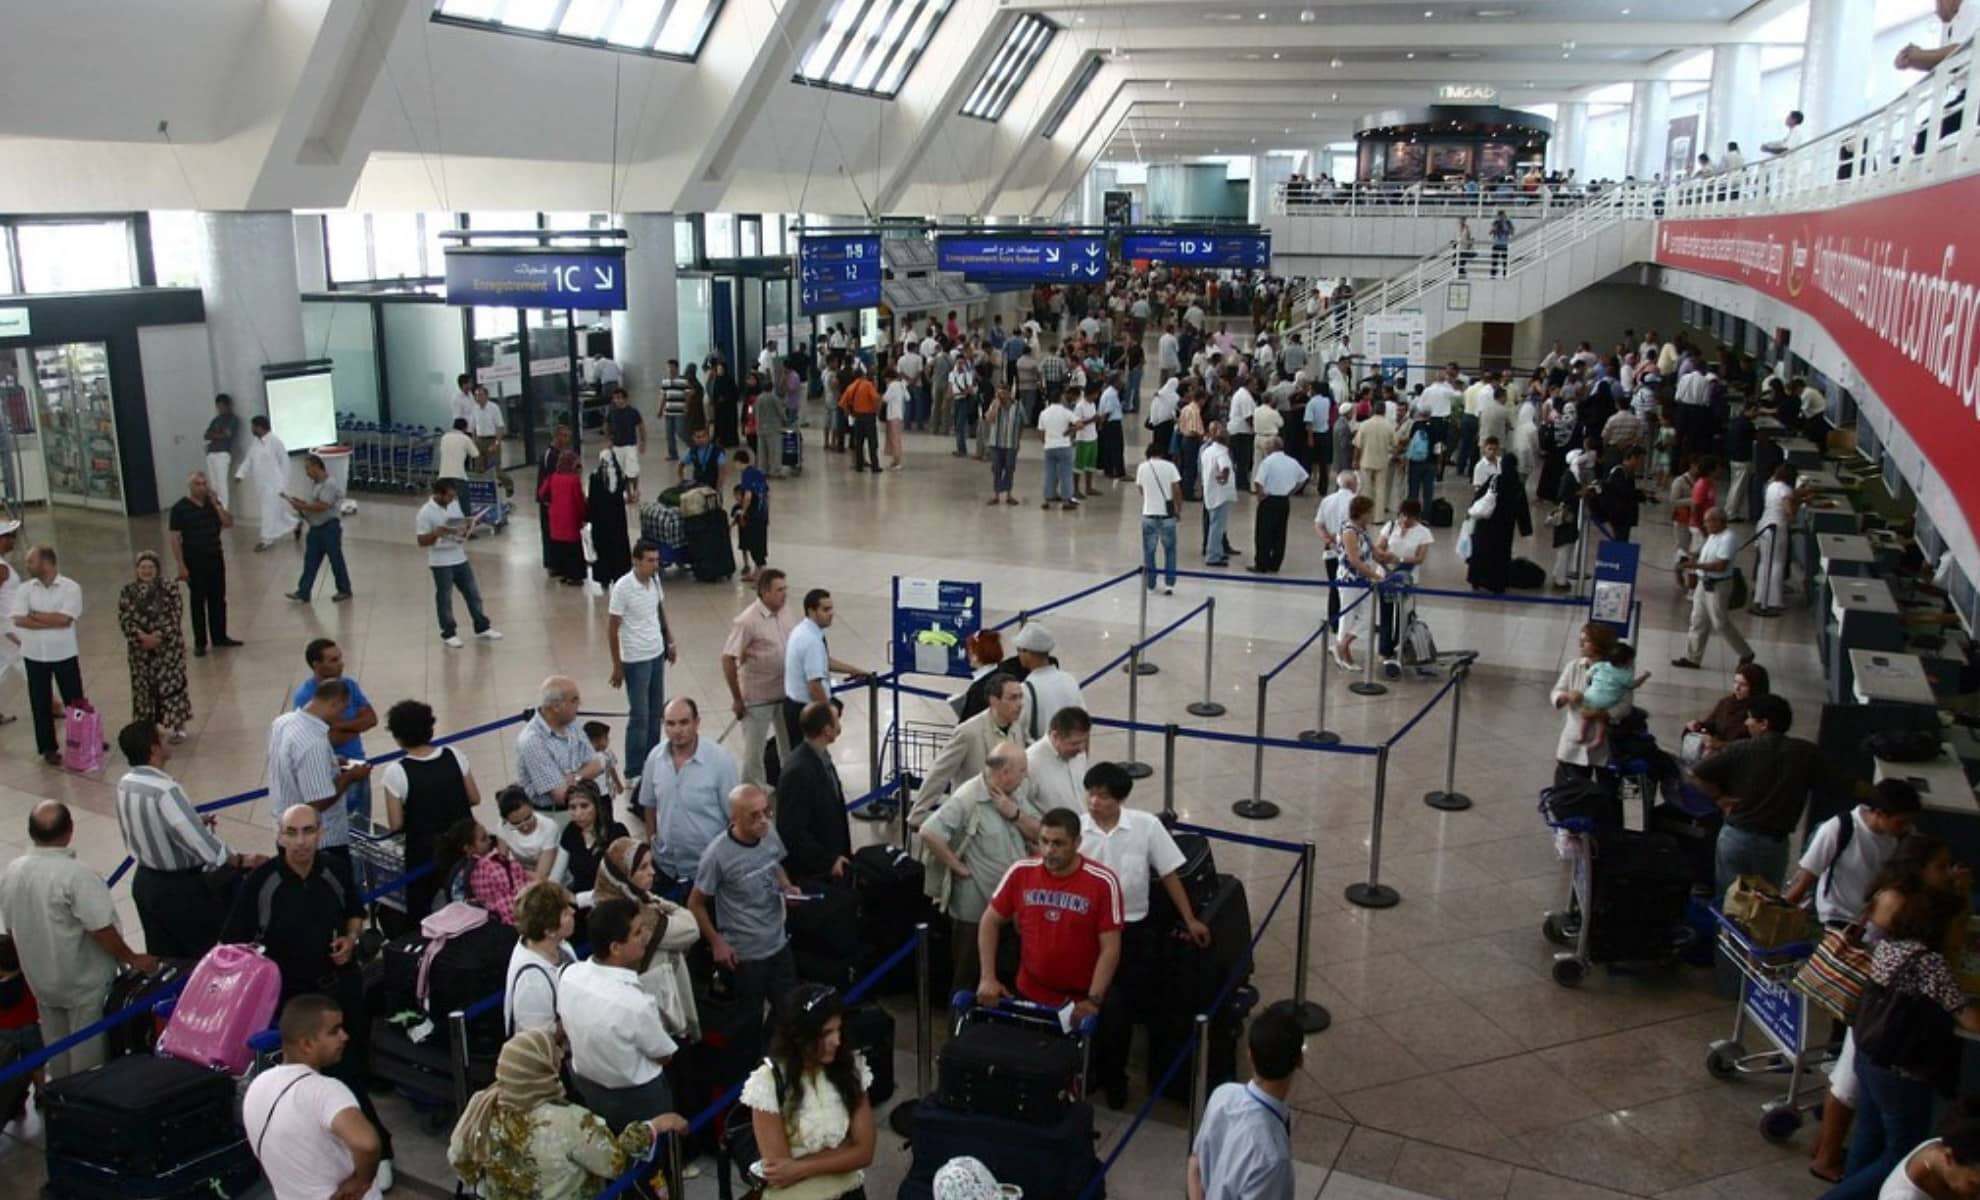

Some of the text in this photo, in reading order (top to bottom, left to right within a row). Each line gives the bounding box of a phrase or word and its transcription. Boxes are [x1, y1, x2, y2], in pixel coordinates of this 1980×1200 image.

[1180, 241, 1196, 254] 1D
[1071, 263, 1079, 275] P
[472, 278, 547, 295] Enregistrement
[552, 266, 581, 292] 1C
[1901, 244, 1980, 422] confianc
